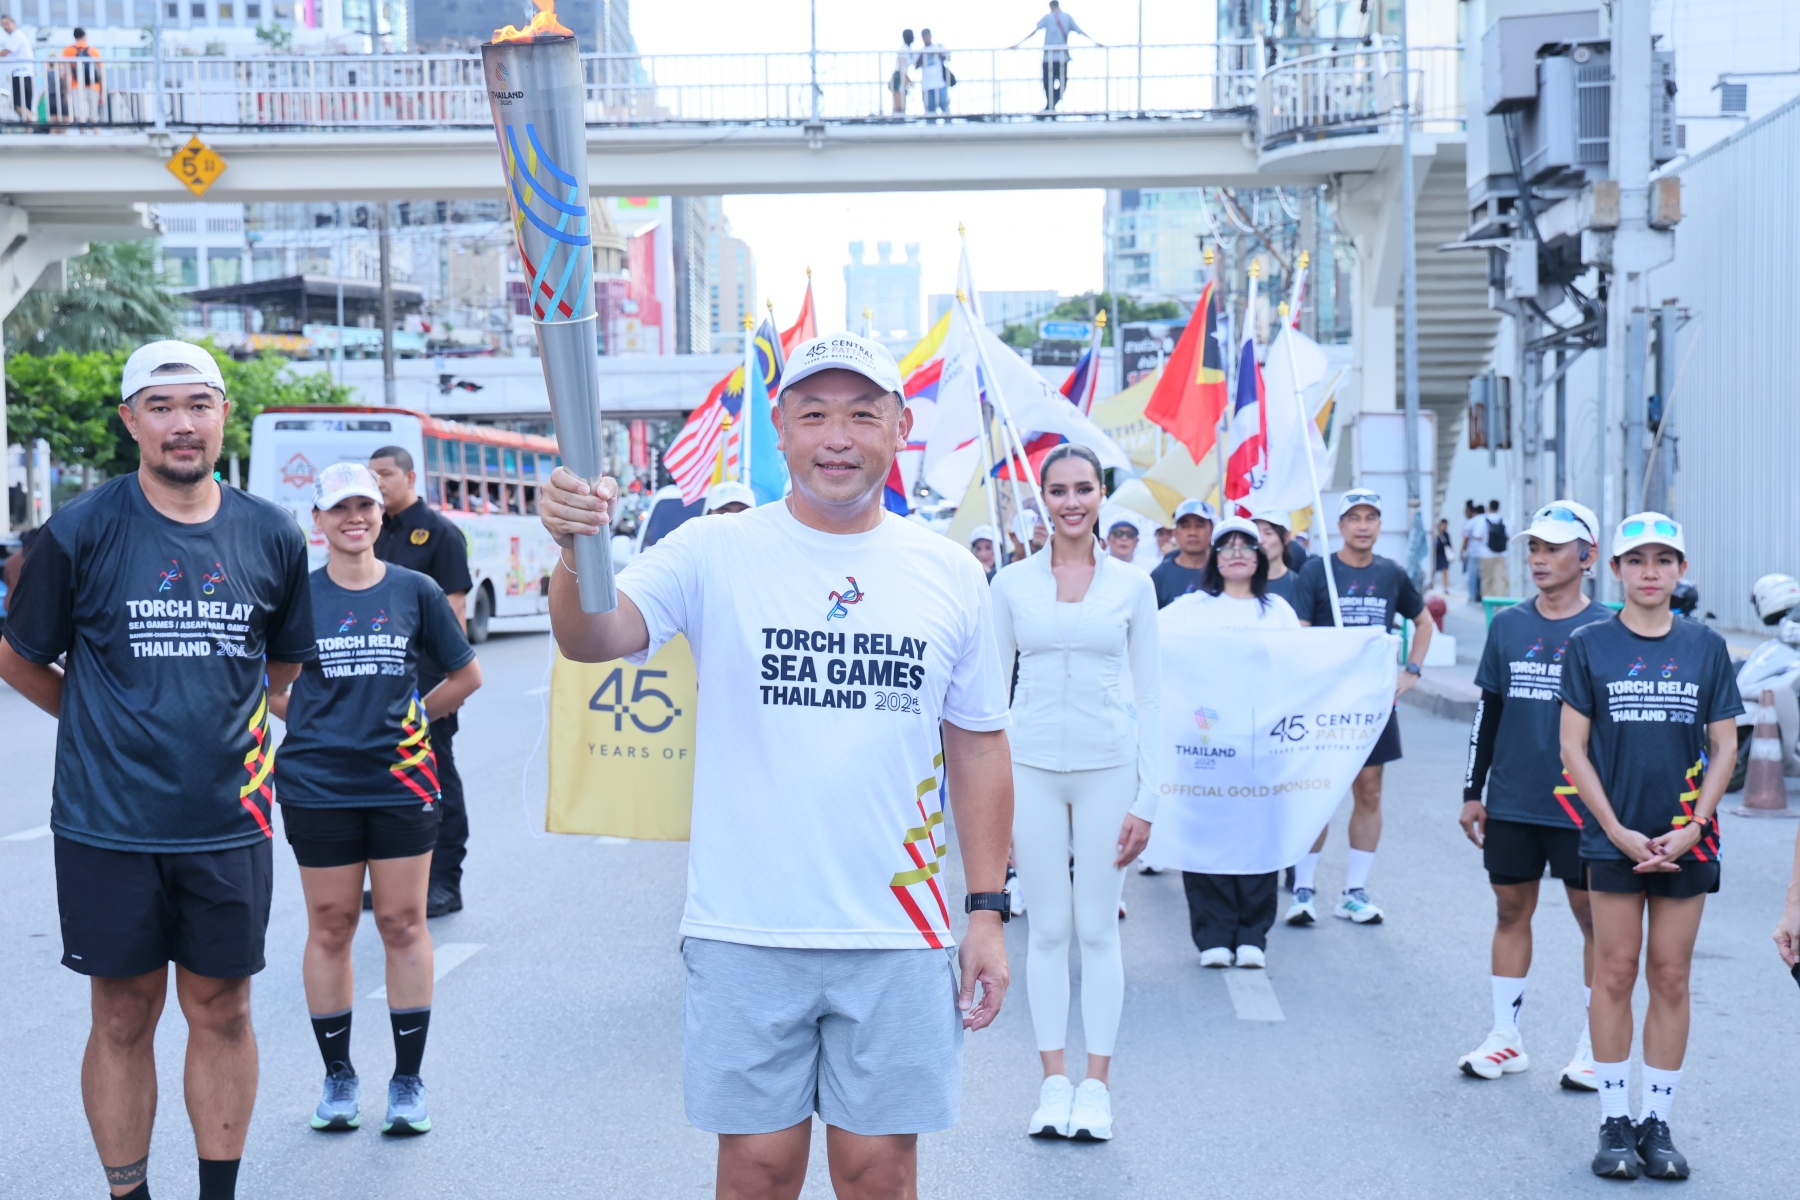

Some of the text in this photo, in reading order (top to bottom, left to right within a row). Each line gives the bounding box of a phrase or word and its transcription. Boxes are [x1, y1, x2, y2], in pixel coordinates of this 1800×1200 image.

[491, 91, 524, 99] THAILAND
[182, 156, 198, 178] 5
[805, 339, 875, 361] 45 CENTRAL
[831, 346, 876, 366] PATTANA
[126, 599, 254, 622] TORCH RELAY
[128, 620, 146, 630] SEA
[146, 620, 175, 629] GAMES
[180, 620, 208, 630] ASEAN
[207, 621, 226, 631] PARA
[226, 622, 250, 633] GAMES
[130, 640, 211, 657] THAILAND
[316, 634, 409, 652] TORCH RELAY
[762, 628, 928, 661] TORCH RELAY
[329, 650, 351, 659] GAMES
[322, 663, 378, 679] THAILAND
[761, 654, 925, 691] SEA GAMES
[1508, 661, 1547, 676] TORCH
[759, 685, 867, 709] THAILAND
[1606, 680, 1699, 698] TORCH RELAY
[588, 668, 682, 733] 45
[1610, 709, 1667, 722] THAILAND
[1270, 714, 1309, 743] 45
[1466, 700, 1485, 780] UNDER ARMOUR
[588, 742, 688, 760] YEARS OF
[1175, 744, 1237, 758] THAILAND
[1194, 757, 1217, 767] 2025
[1159, 777, 1332, 799] OFFICIAL GOLD SPONSOR
